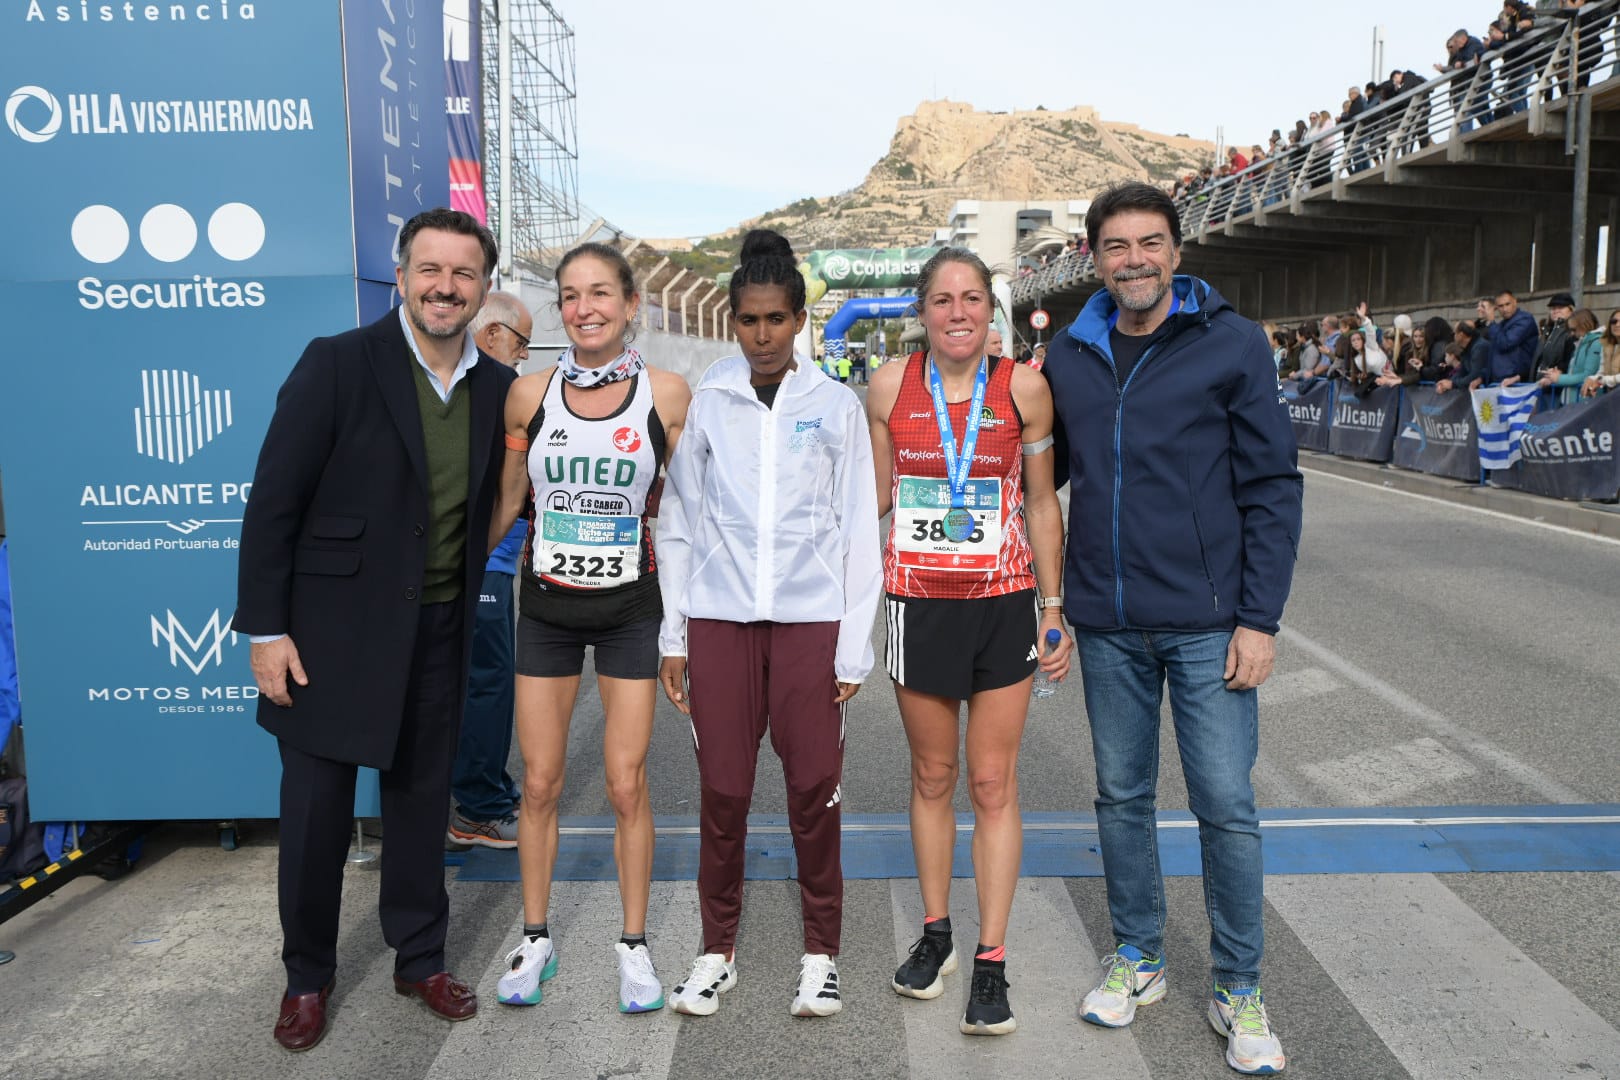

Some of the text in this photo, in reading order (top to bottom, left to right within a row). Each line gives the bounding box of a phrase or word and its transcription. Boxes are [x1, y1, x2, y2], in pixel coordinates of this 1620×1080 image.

[26, 0, 256, 22] Asistencia
[69, 93, 314, 134] HLA VISTAHERMOSA
[852, 258, 920, 279] Coplaca
[78, 274, 266, 310] Securitas
[1287, 403, 1322, 421] cante
[1520, 428, 1613, 457] licante
[544, 456, 638, 487] UNED
[80, 482, 252, 506] ALICANTE PO
[594, 500, 624, 510] CABEZO
[911, 519, 984, 543] 385
[84, 537, 239, 552] Autoridad Portuaria de
[550, 552, 624, 578] 2323
[89, 686, 260, 701] MOTOS MED
[159, 705, 245, 714] DESDE 1986
